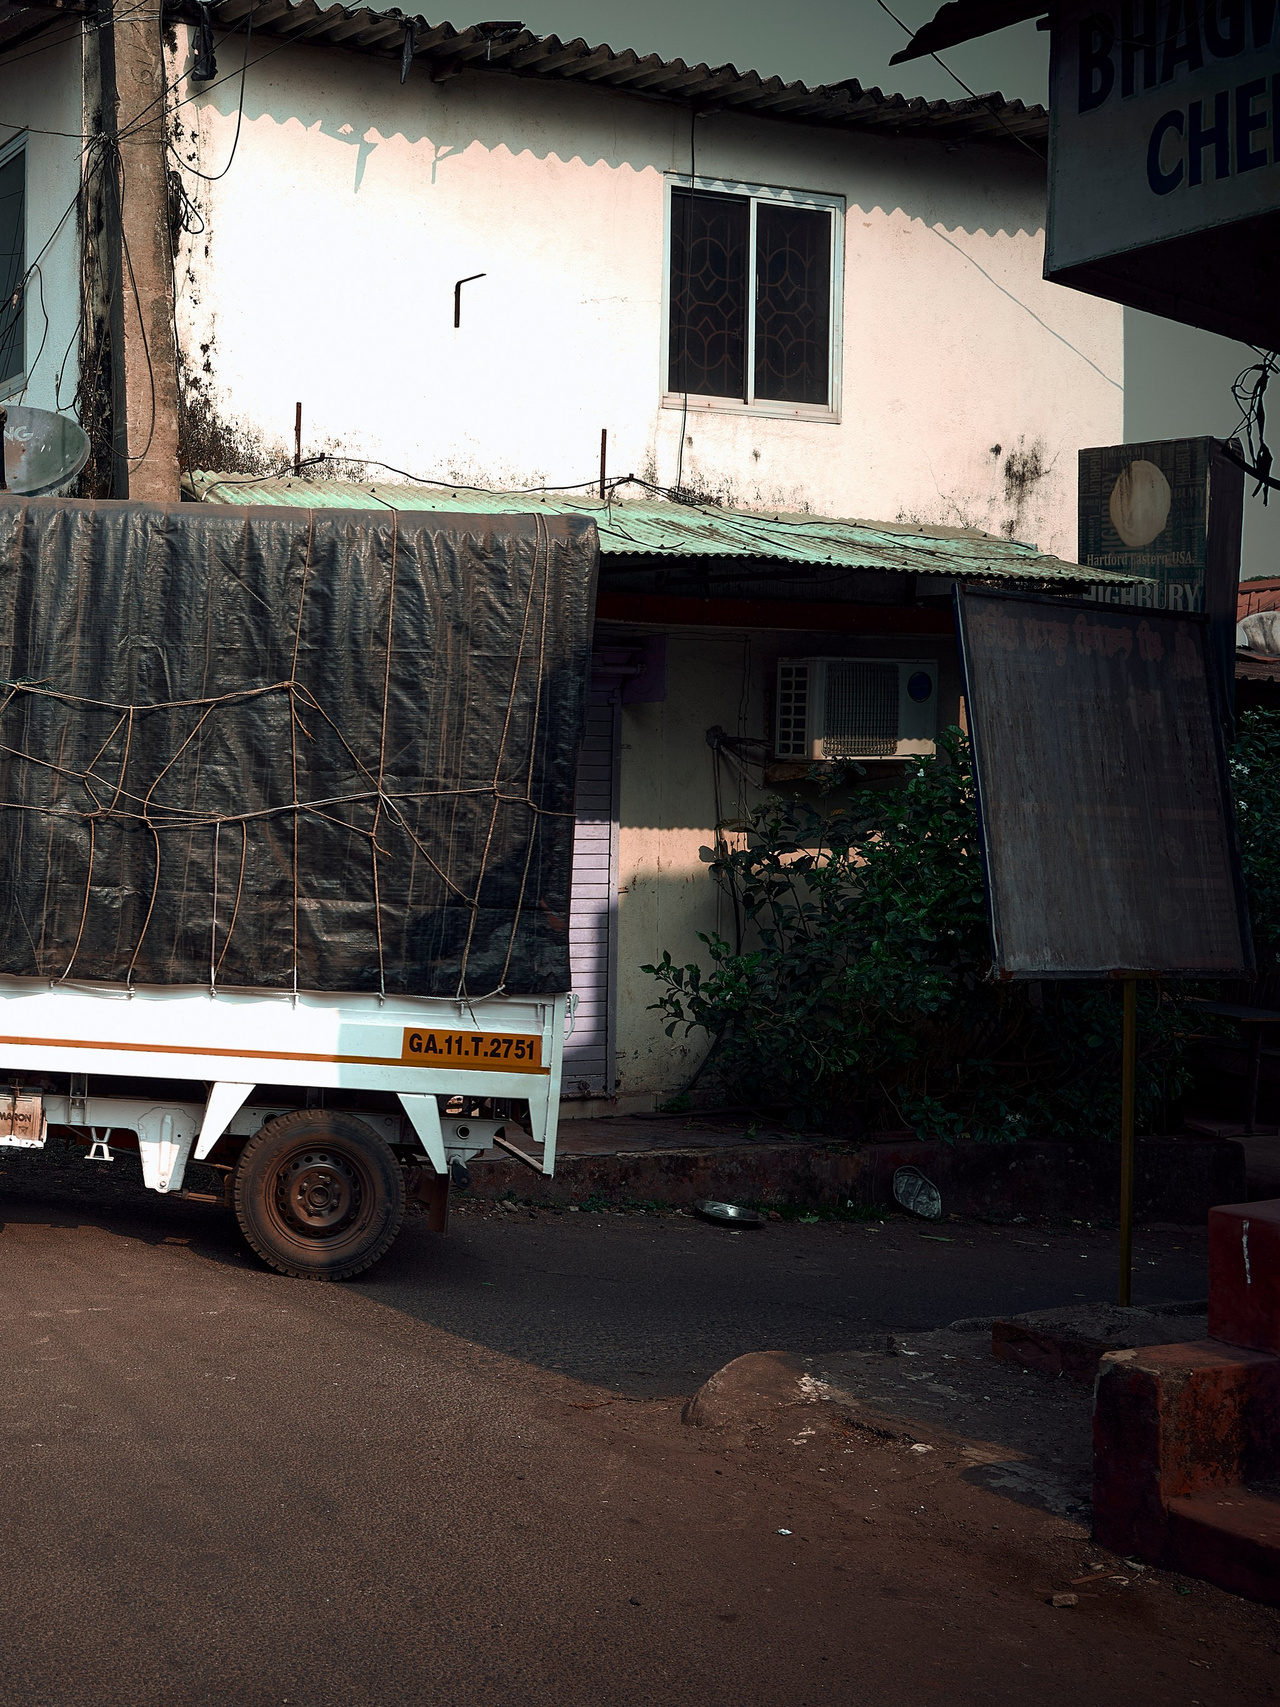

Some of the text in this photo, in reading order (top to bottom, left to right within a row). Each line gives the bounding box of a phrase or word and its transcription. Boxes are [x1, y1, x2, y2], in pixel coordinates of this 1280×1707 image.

[1147, 73, 1280, 196] CHE
[1086, 553, 1128, 567] Hartford
[409, 1033, 535, 1060] GA.11.T.2751
